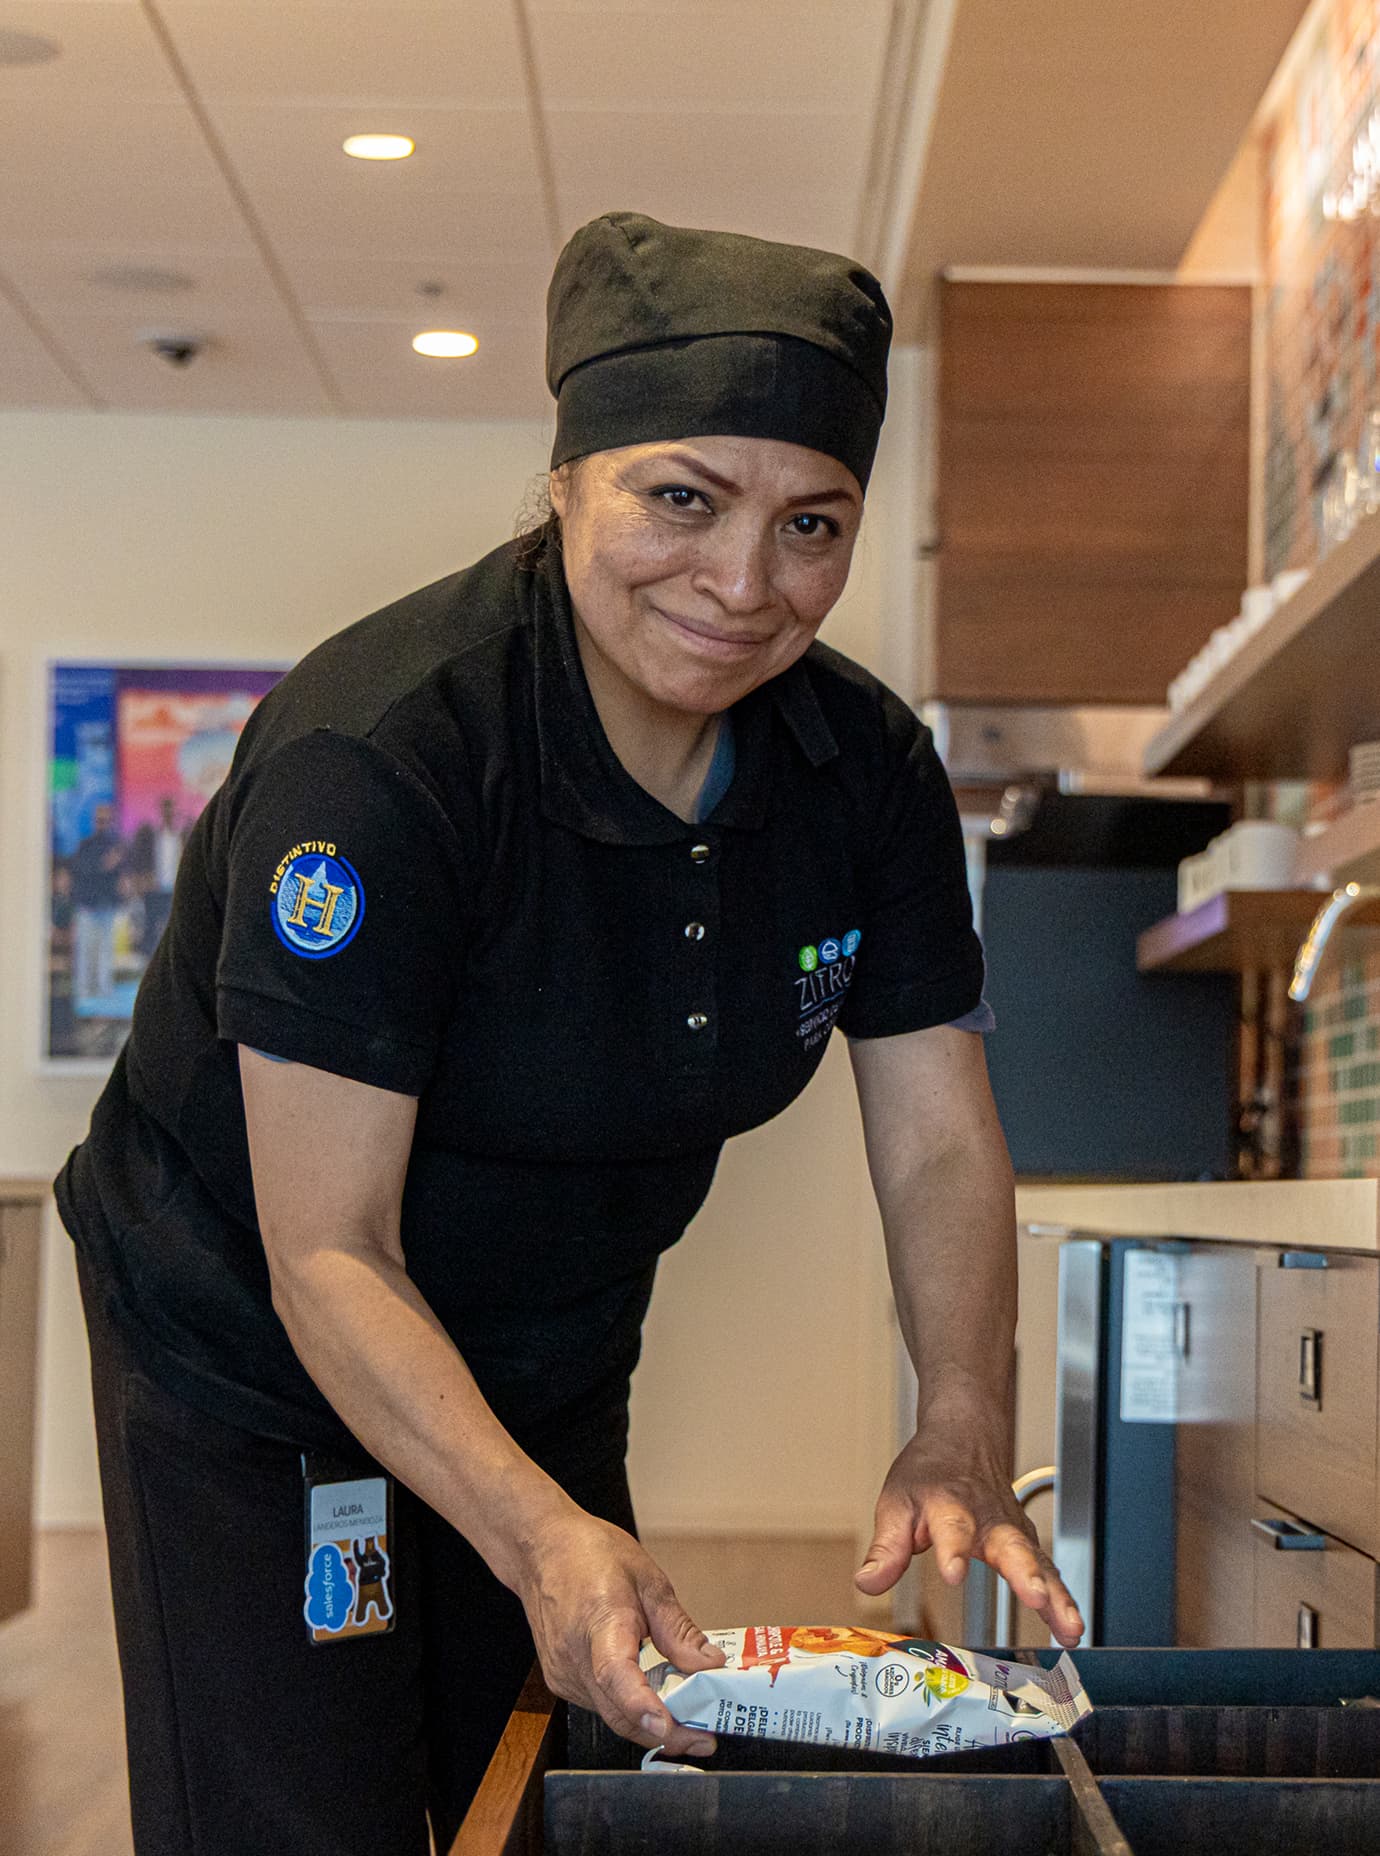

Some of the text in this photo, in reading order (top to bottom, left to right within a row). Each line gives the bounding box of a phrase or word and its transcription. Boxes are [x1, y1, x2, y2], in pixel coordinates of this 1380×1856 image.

[270, 841, 337, 894] DISTINTIVO
[287, 872, 345, 937] H
[333, 1504, 364, 1518] LAURA
[322, 1553, 336, 1619] salesforce
